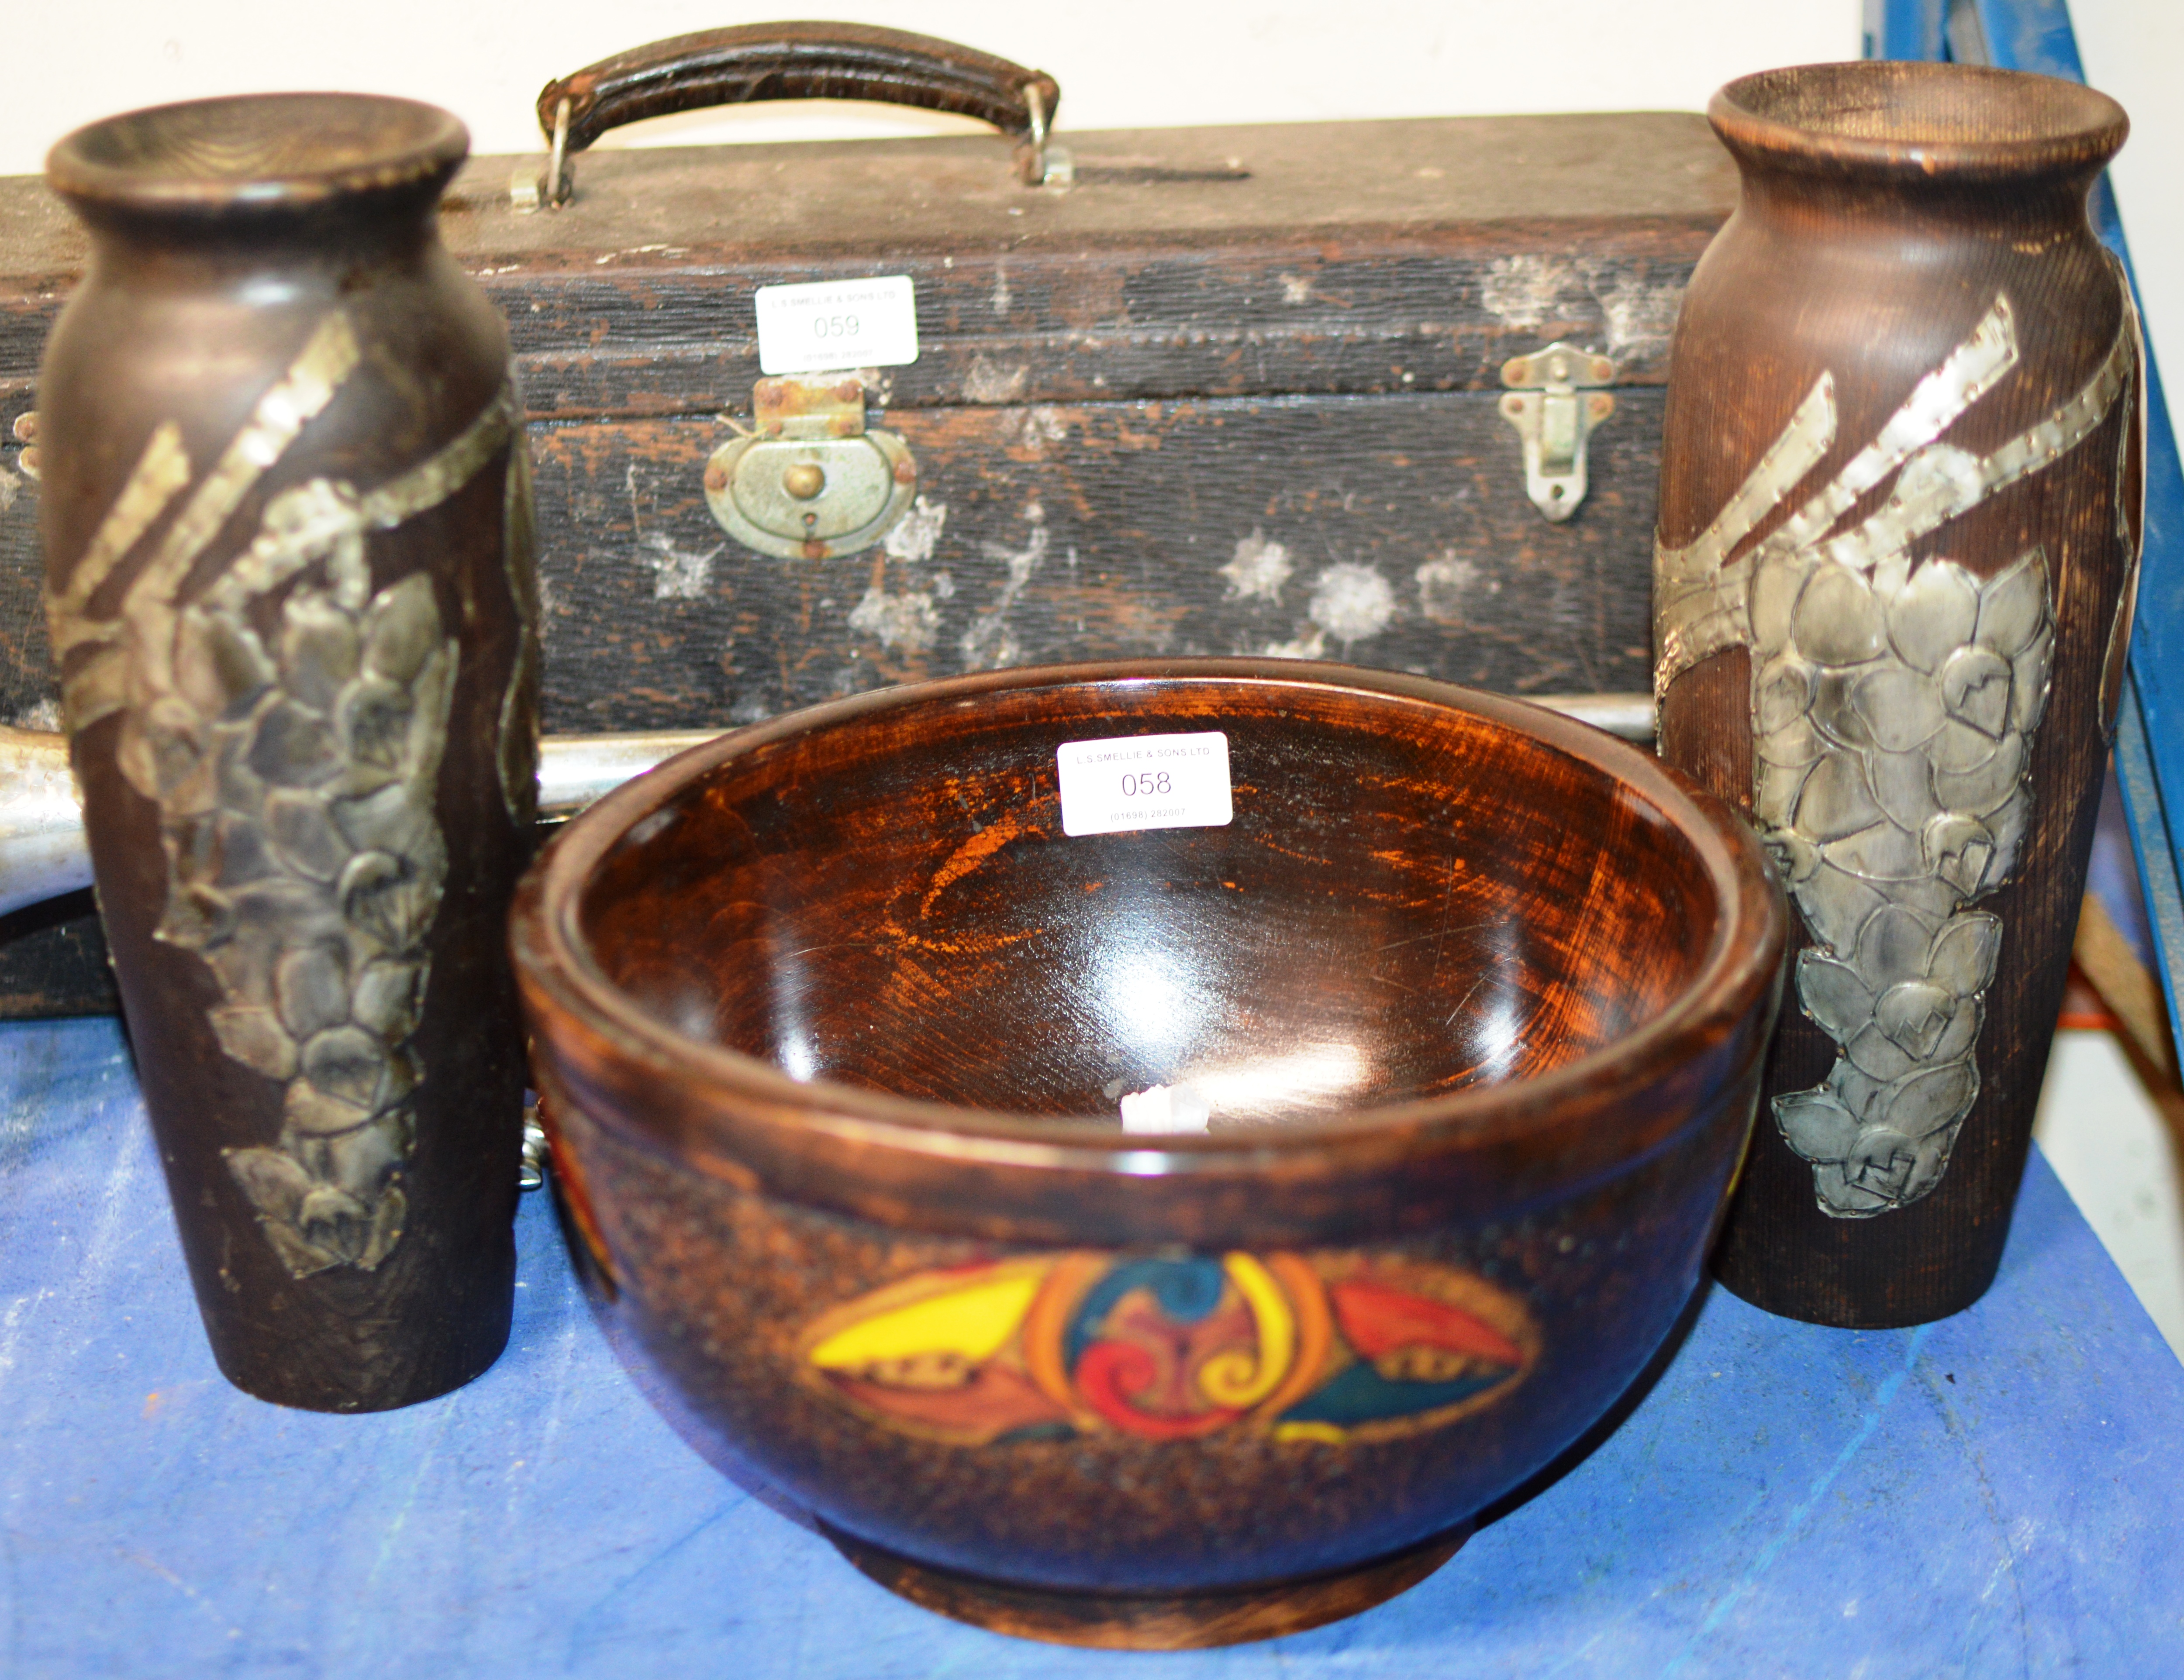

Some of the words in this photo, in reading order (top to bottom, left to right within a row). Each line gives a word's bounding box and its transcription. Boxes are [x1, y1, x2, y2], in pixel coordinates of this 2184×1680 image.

[846, 293, 874, 302] SONS
[877, 290, 896, 300] LTD
[814, 314, 859, 338] 059
[1076, 750, 1142, 764] L.S.SMELLIE
[1157, 748, 1187, 757] SONS
[1190, 747, 1210, 756] LTD
[1121, 771, 1172, 796] 058
[1111, 810, 1147, 823] (01698)
[1151, 808, 1185, 818] 282007
